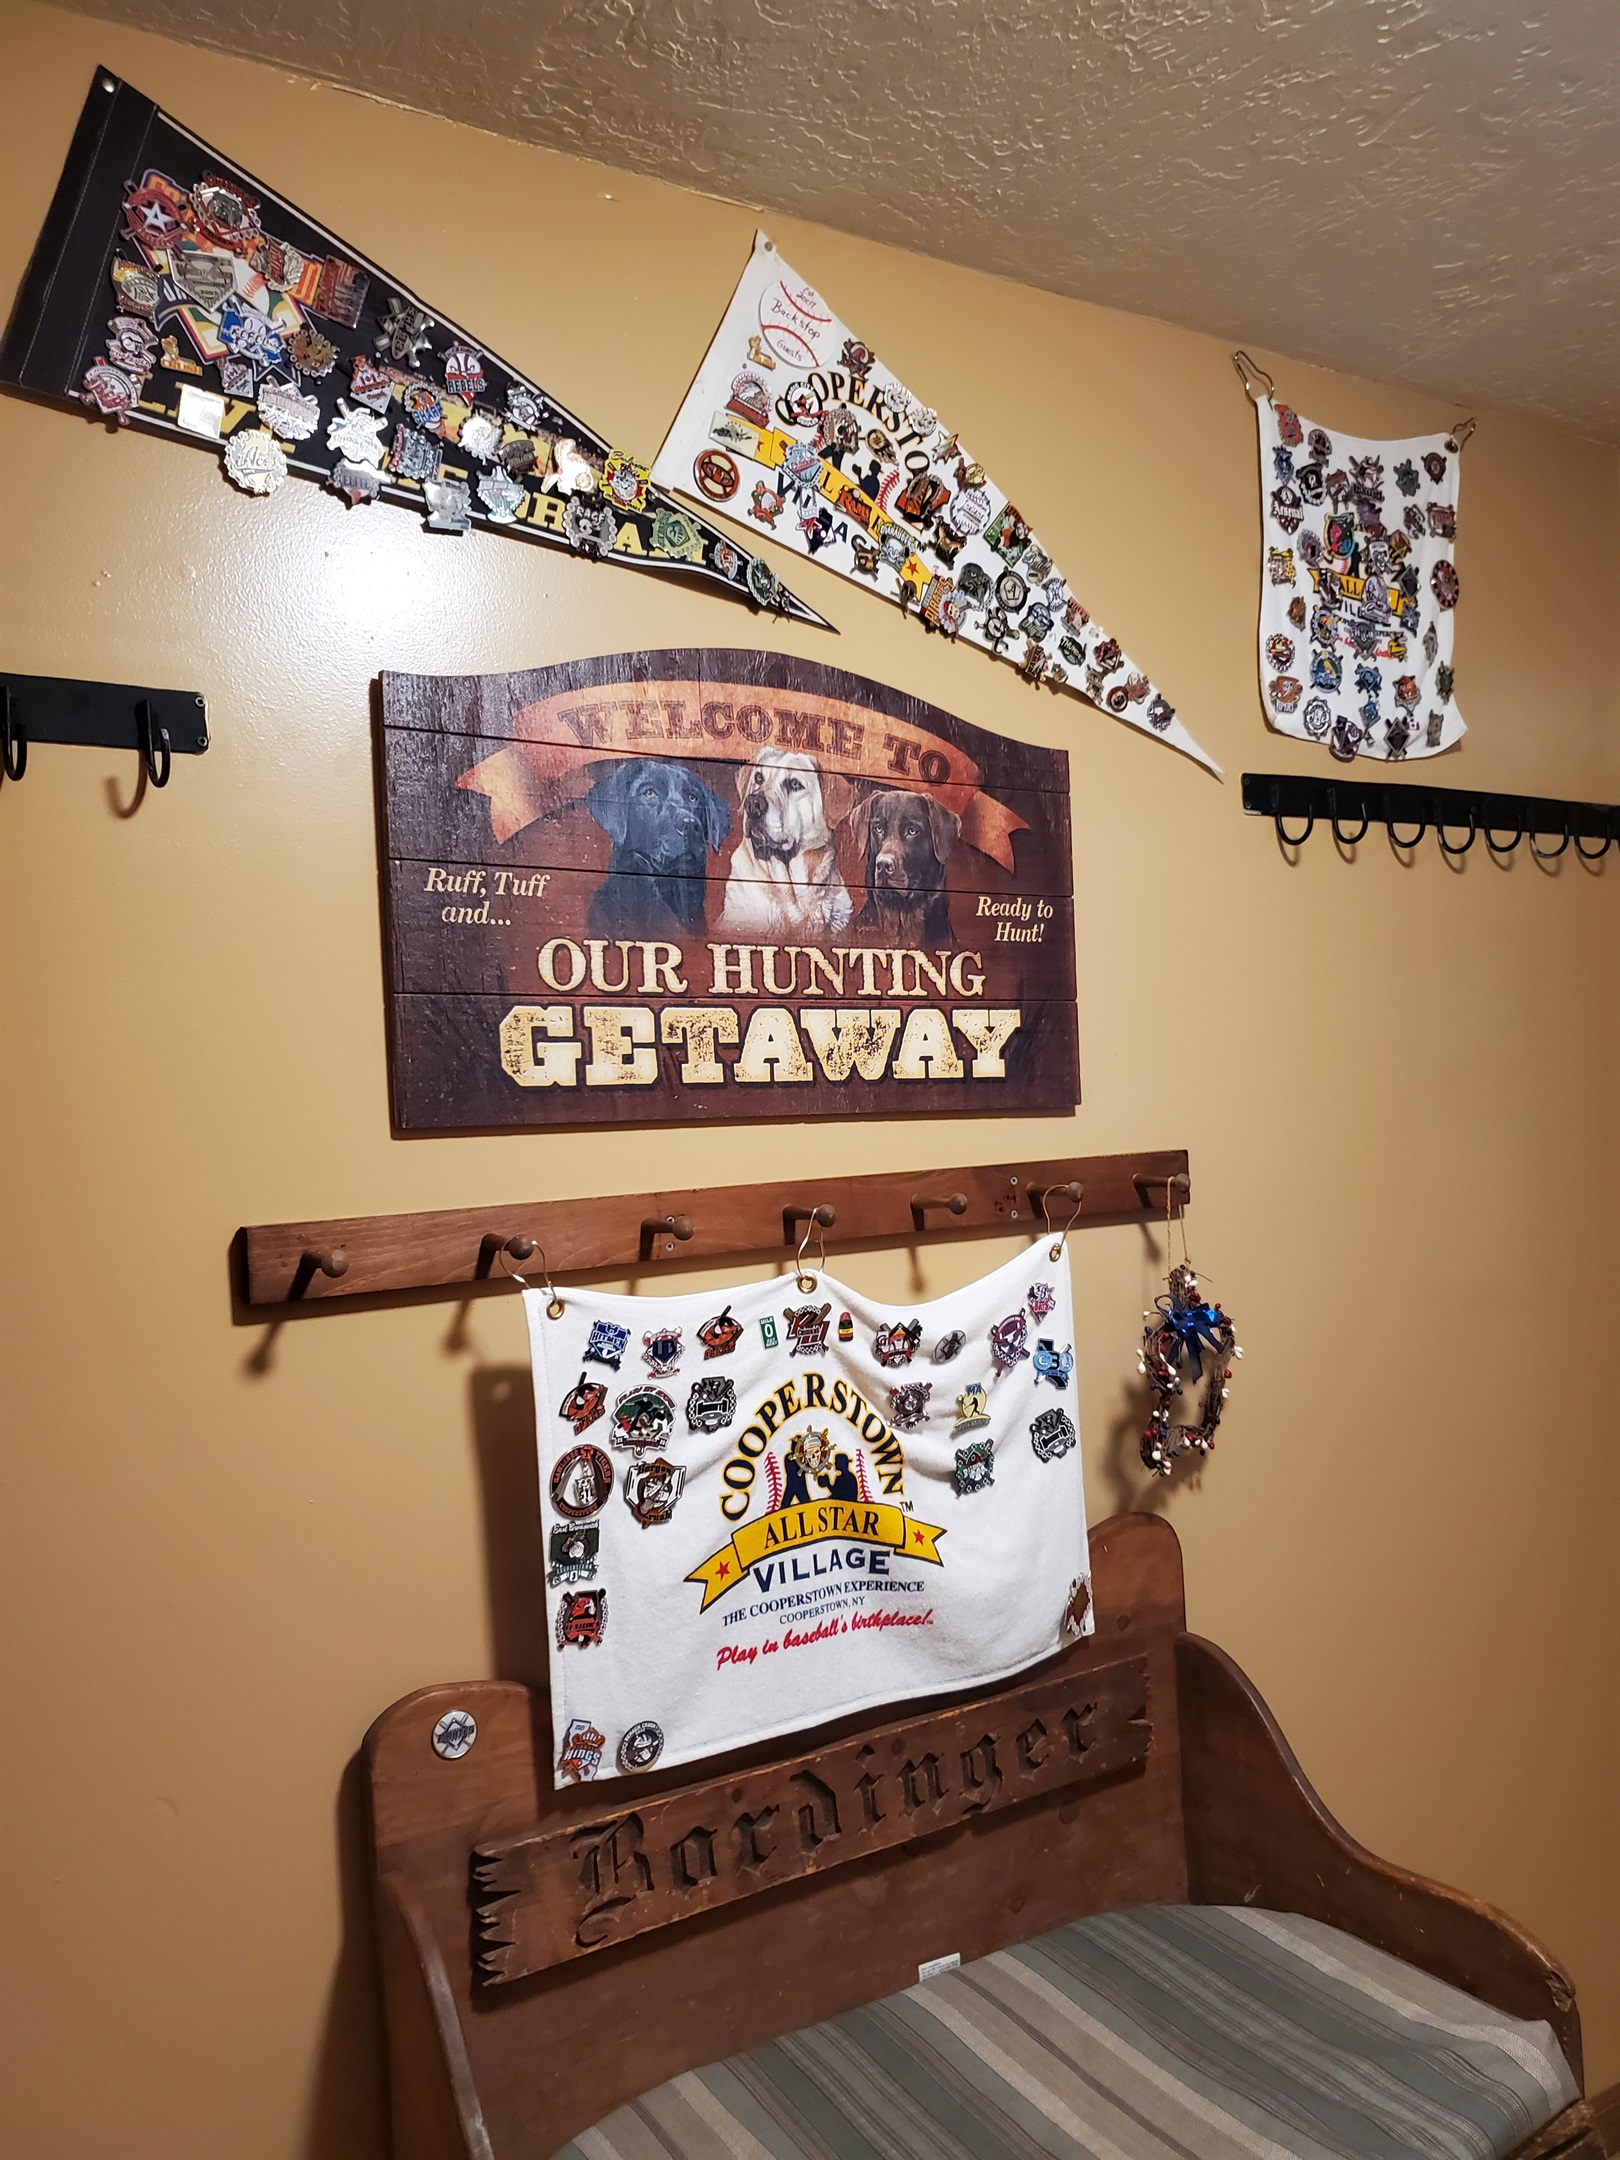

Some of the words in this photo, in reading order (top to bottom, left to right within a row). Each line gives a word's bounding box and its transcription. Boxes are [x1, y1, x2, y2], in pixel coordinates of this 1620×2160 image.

[447, 378, 486, 393] REBELS
[575, 505, 606, 527] RAGE
[838, 489, 872, 521] RAMS
[1272, 500, 1304, 521] Arsenal
[924, 575, 956, 627] PIRATES
[557, 699, 865, 761] WELCOME
[882, 732, 952, 784] TO
[423, 867, 487, 898] Ruff,
[493, 871, 551, 897] Tuff
[441, 900, 512, 926] and...
[975, 896, 1032, 921] Ready
[1036, 899, 1054, 919] to
[994, 921, 1045, 943] Hunt!
[537, 937, 689, 994] OUR
[706, 942, 986, 997] HUNTING
[499, 1004, 1022, 1088] GETAWAY
[591, 1330, 627, 1350] HITMEN
[967, 1384, 982, 1396] MA
[573, 1404, 606, 1437] DUCKS
[720, 1371, 905, 1523] COOPERSTOWN
[595, 1449, 612, 1485] TIGERS
[764, 1506, 814, 1549] ALL
[817, 1506, 880, 1536] STAR
[752, 1547, 891, 1594] VILLAGE
[722, 1609, 748, 1627] THE
[749, 1582, 843, 1618] COOPERSTOWN
[844, 1580, 925, 1593] EXPERIENCE
[779, 1598, 851, 1625] COOPERSTOWN,
[851, 1596, 866, 1607] NY
[716, 1645, 759, 1672] Play
[762, 1639, 779, 1656] in
[783, 1616, 848, 1651] baseball's
[437, 1723, 476, 1745] PIRATES
[563, 1748, 601, 1767] KINGS
